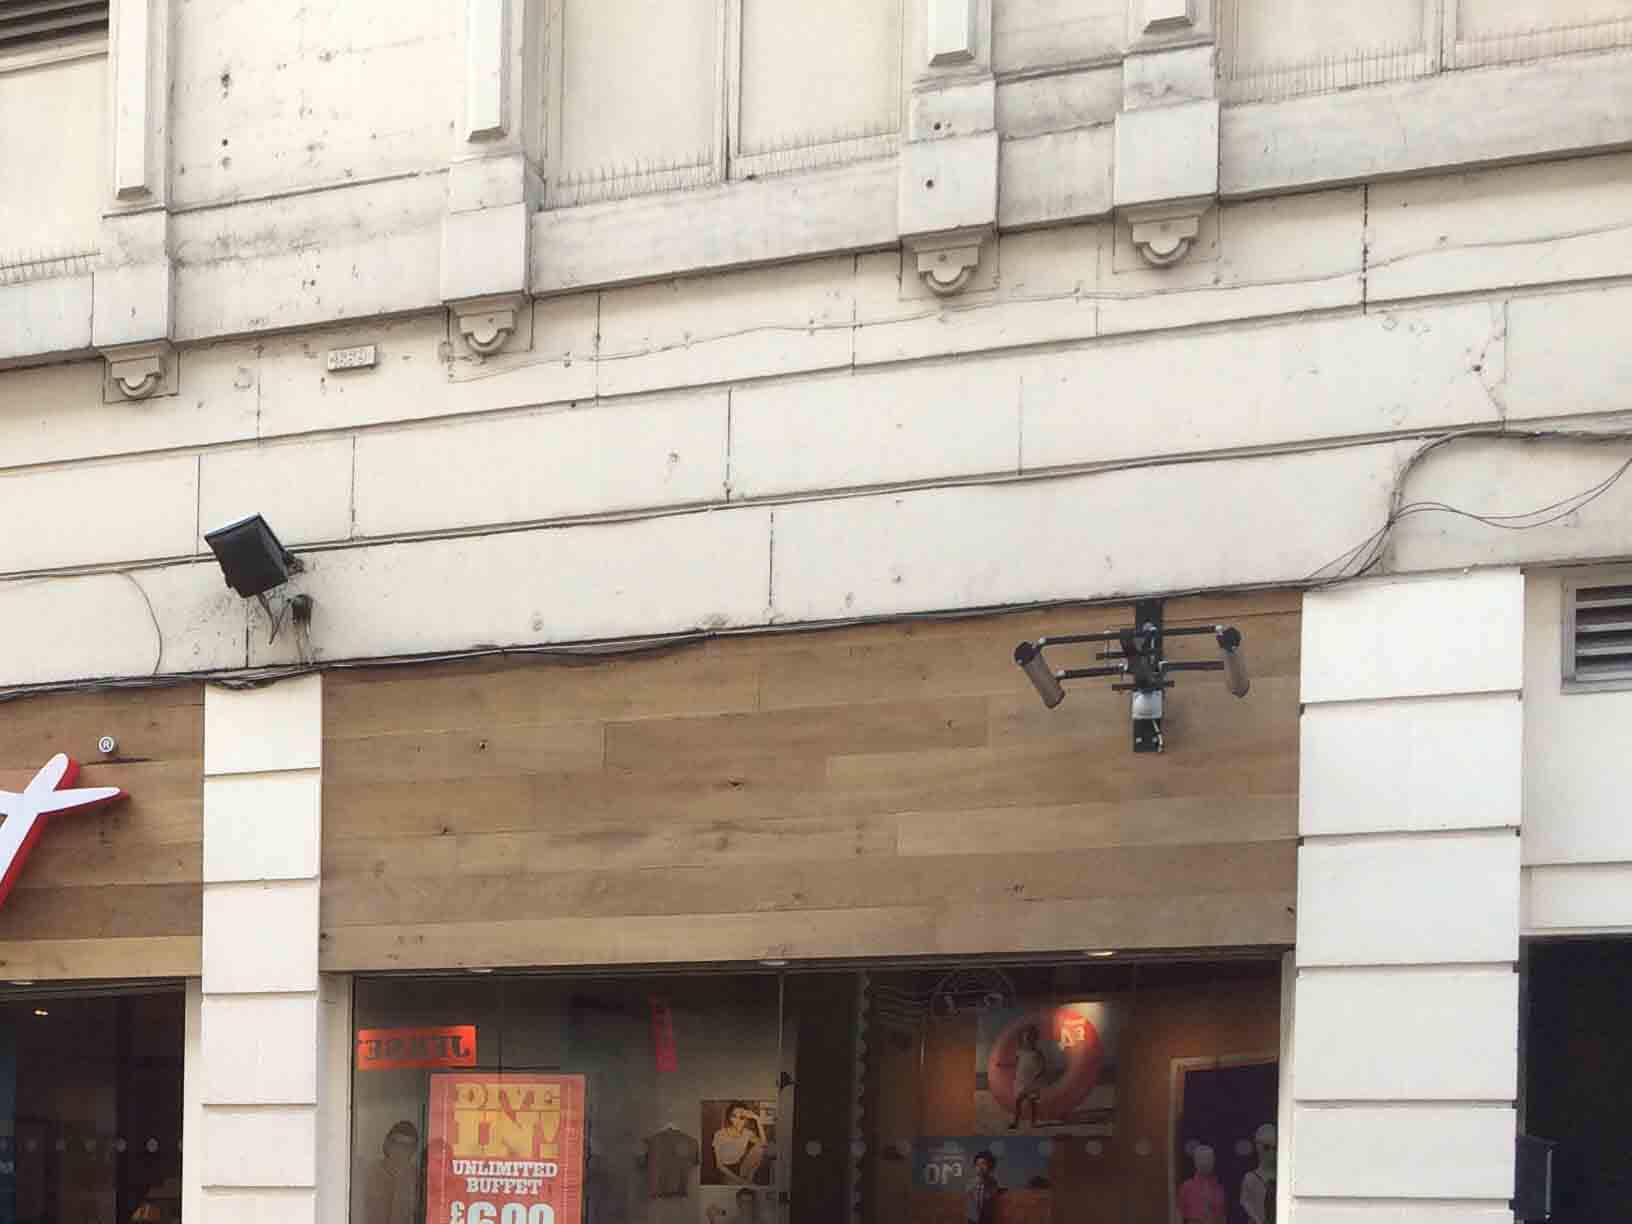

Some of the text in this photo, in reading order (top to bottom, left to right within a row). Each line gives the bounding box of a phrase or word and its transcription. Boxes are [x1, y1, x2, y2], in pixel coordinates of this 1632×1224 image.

[455, 1084, 560, 1111] DIVE
[452, 1111, 560, 1159] IN!
[452, 1159, 557, 1178] UNLIMITED
[466, 1177, 543, 1195] BUFFET
